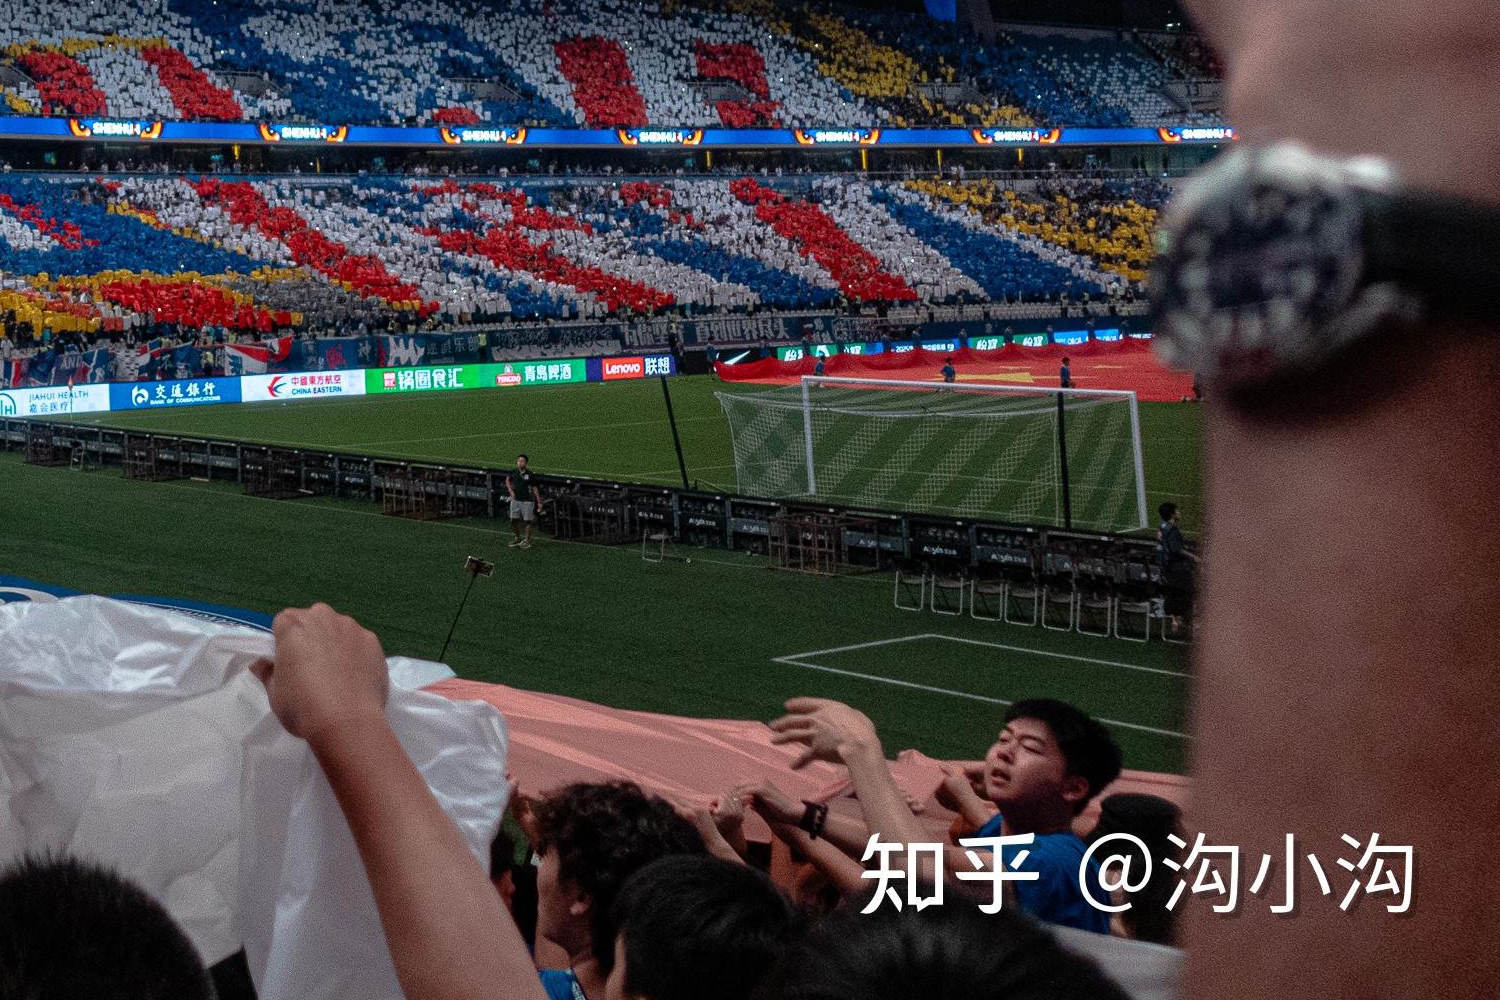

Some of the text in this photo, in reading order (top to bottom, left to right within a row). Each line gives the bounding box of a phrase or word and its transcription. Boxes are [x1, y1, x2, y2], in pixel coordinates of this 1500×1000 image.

[524, 363, 572, 382] 青岛啤酒
[605, 362, 640, 376] Lenovo
[644, 357, 670, 376] 联想
[29, 389, 89, 403] JIAHUI HEALTH
[292, 385, 343, 396] CHINA EASTERN
